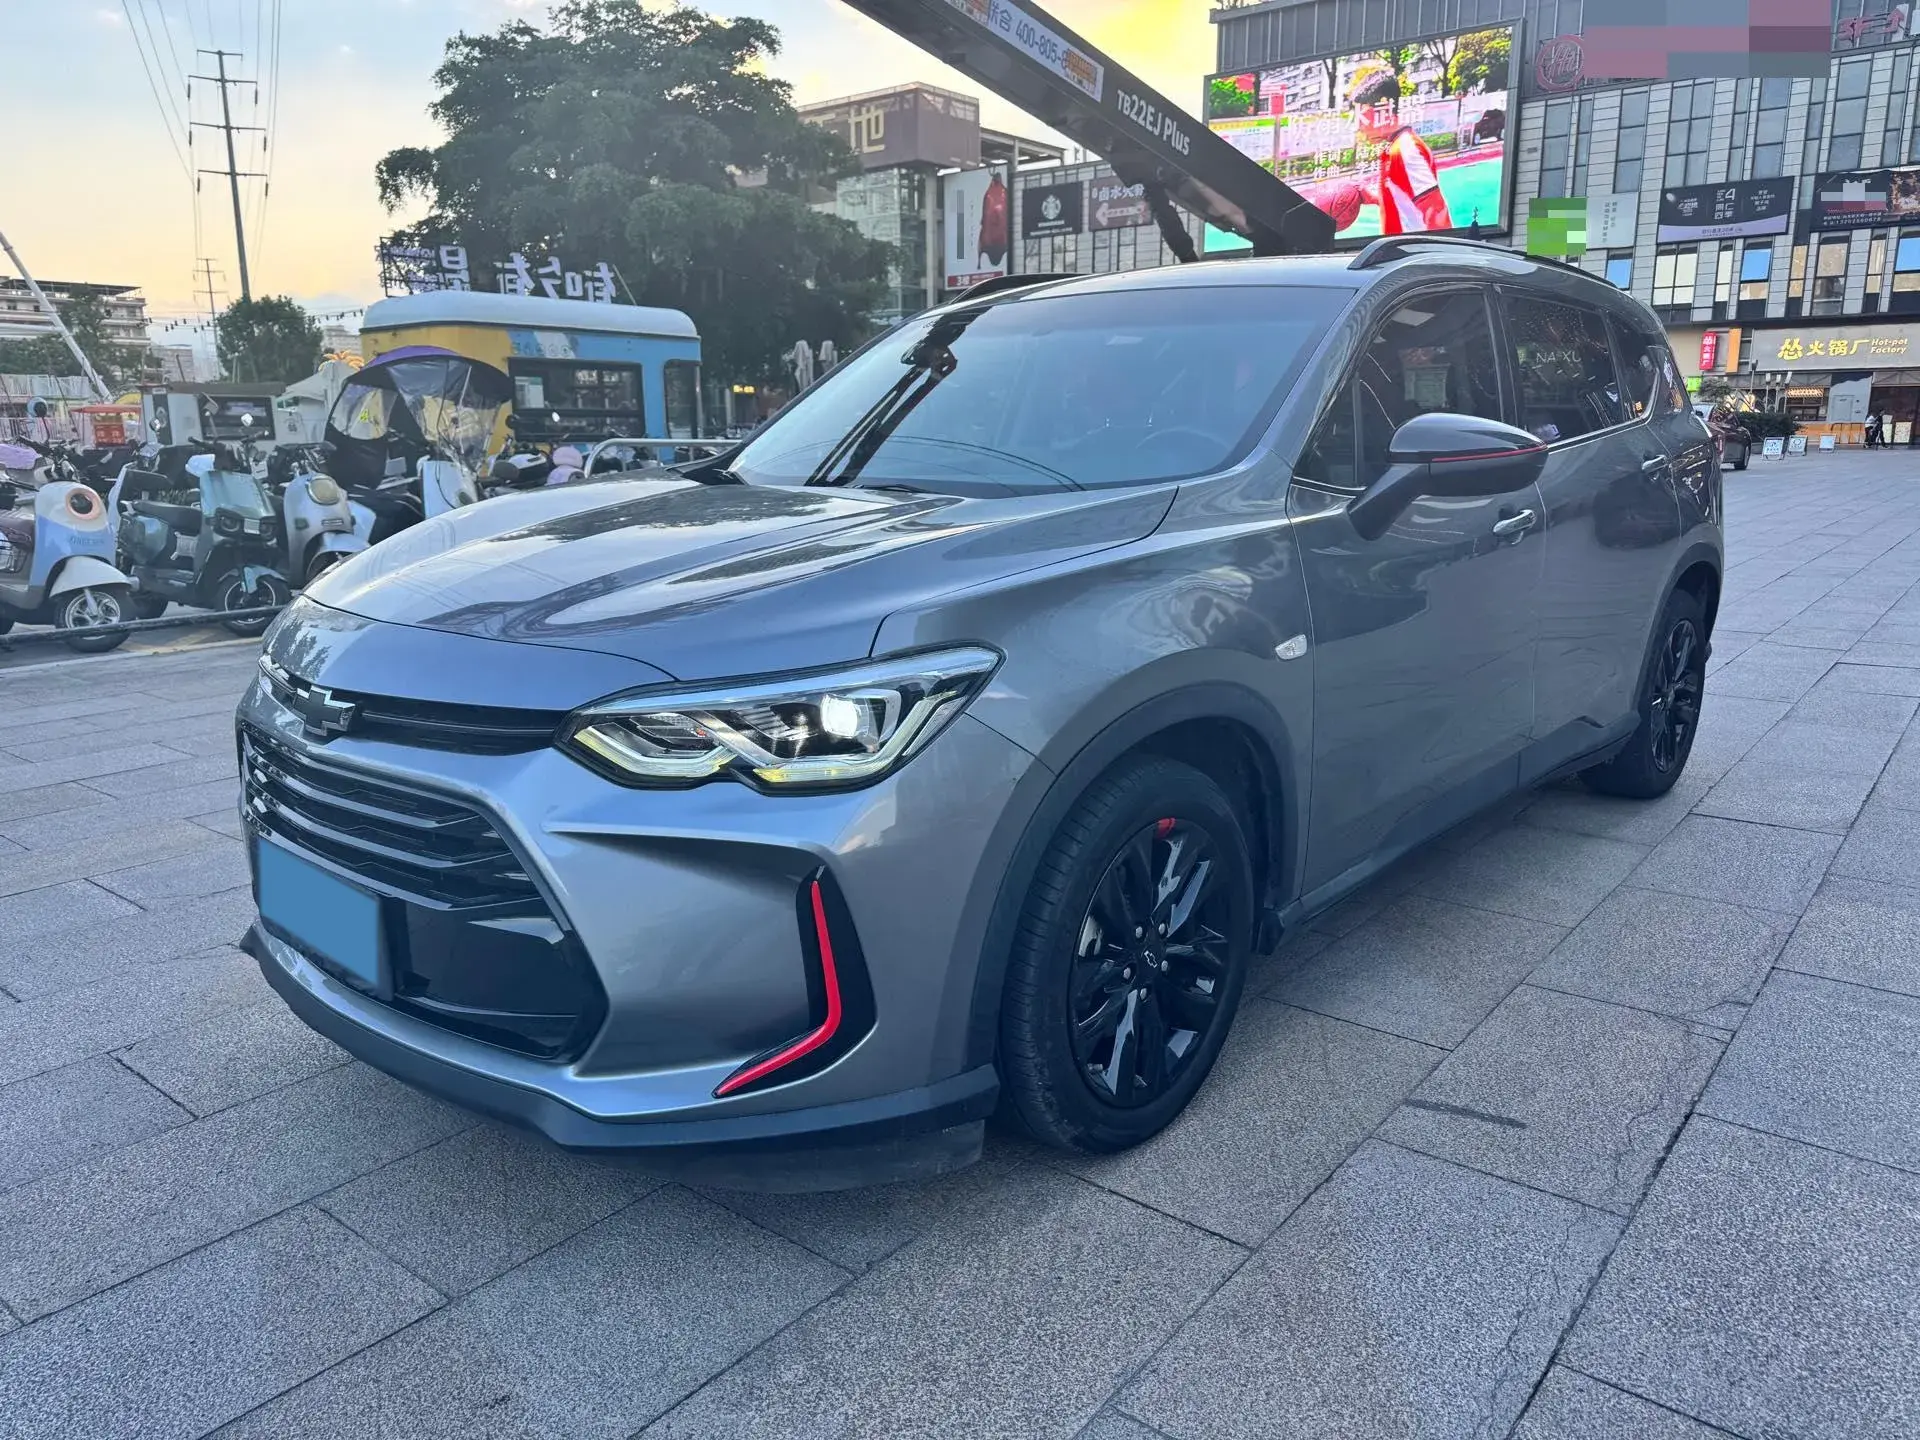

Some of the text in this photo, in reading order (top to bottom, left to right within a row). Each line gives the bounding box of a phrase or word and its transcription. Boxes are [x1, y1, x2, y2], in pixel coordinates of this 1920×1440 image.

[1117, 88, 1190, 156] TB22EJ Plus
[1777, 338, 1869, 361] 怂火锅厂
[1870, 346, 1907, 354] Factory
[1871, 338, 1908, 347] Hot-pot
